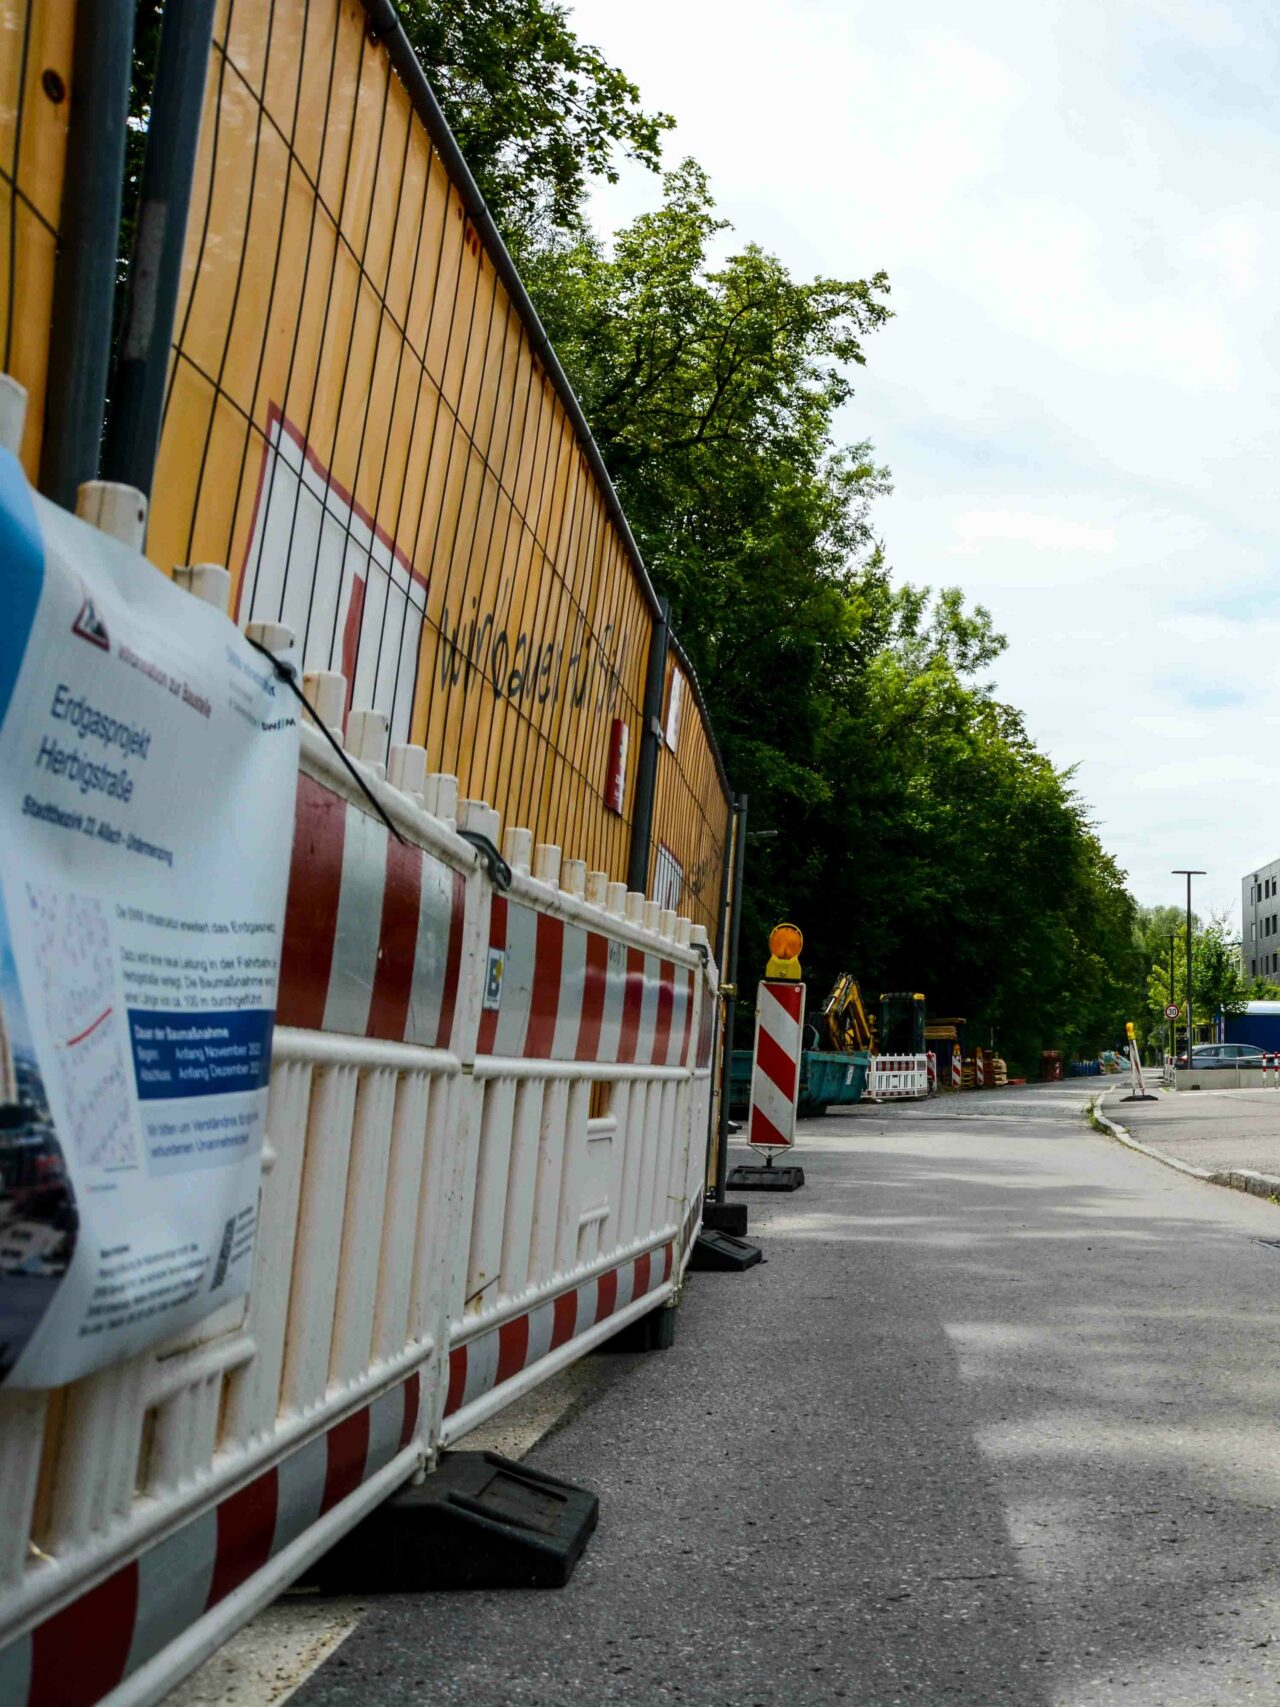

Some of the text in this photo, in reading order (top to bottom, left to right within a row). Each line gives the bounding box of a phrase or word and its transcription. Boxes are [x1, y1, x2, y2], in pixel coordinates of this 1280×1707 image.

[51, 683, 151, 760] Erdgasprojekt
[35, 734, 133, 804] Herbigstraße
[204, 1043, 247, 1059] November
